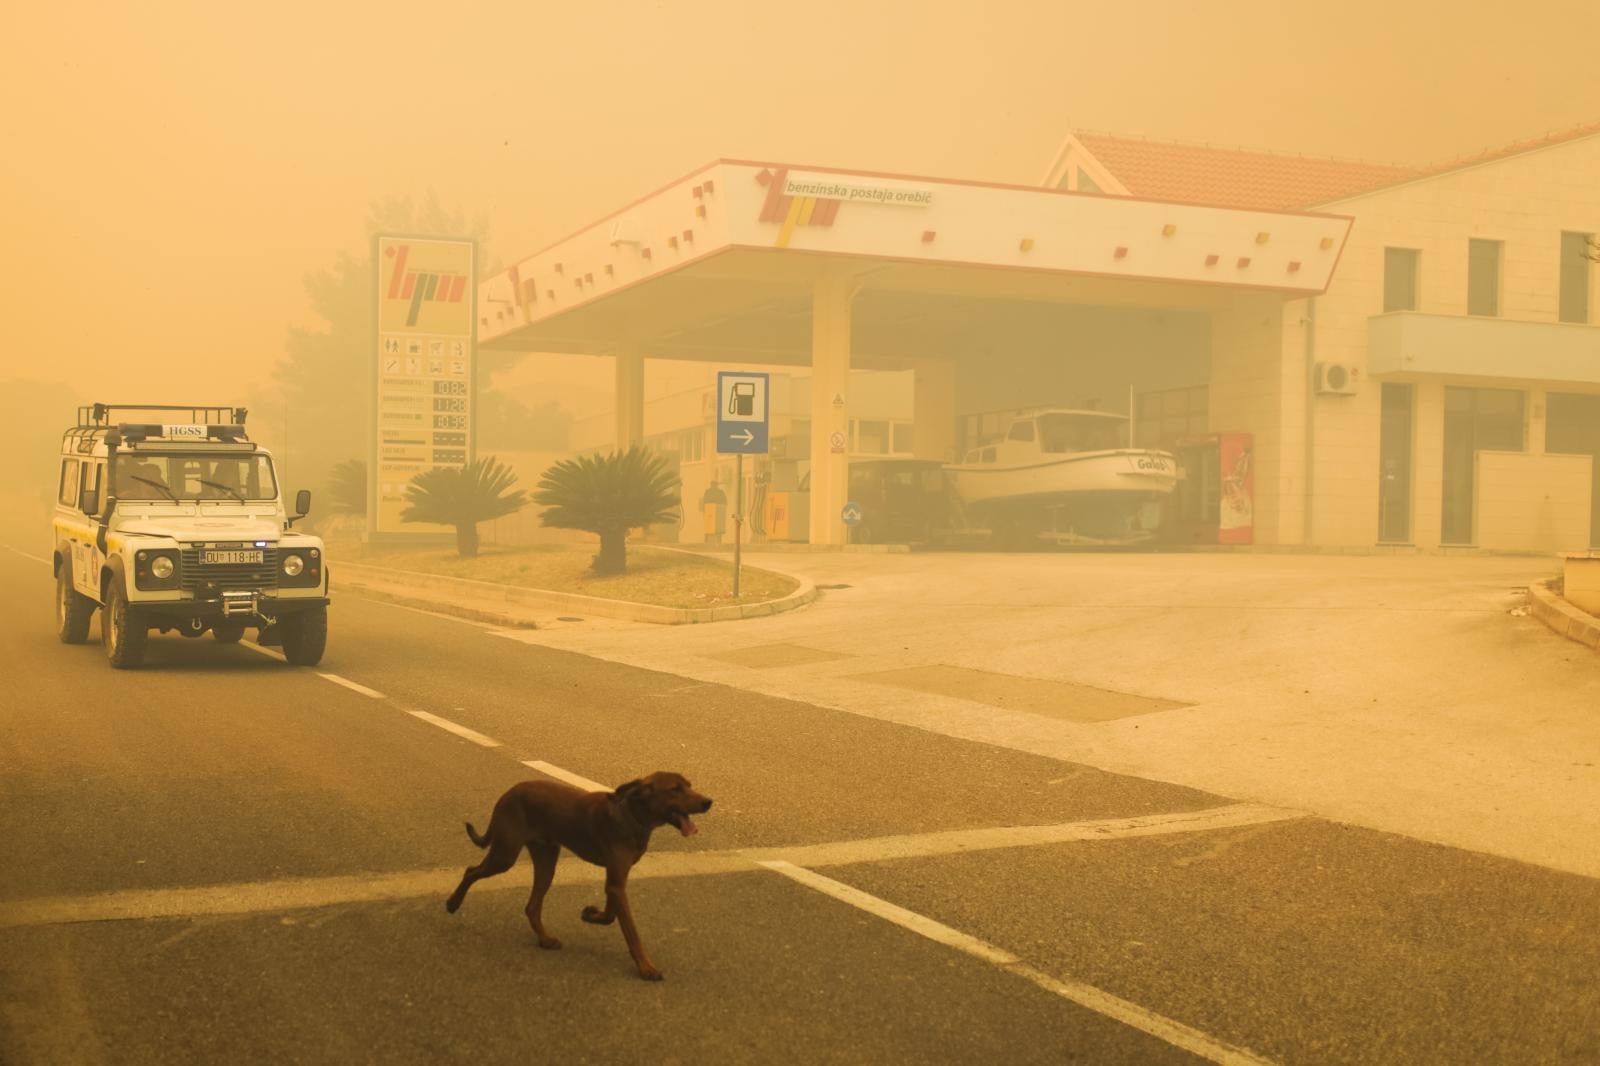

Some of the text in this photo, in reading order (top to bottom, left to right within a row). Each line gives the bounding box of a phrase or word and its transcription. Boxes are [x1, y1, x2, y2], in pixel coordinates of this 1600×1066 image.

[787, 181, 932, 204] benzinska postaja orebić
[169, 426, 202, 436] HGSS
